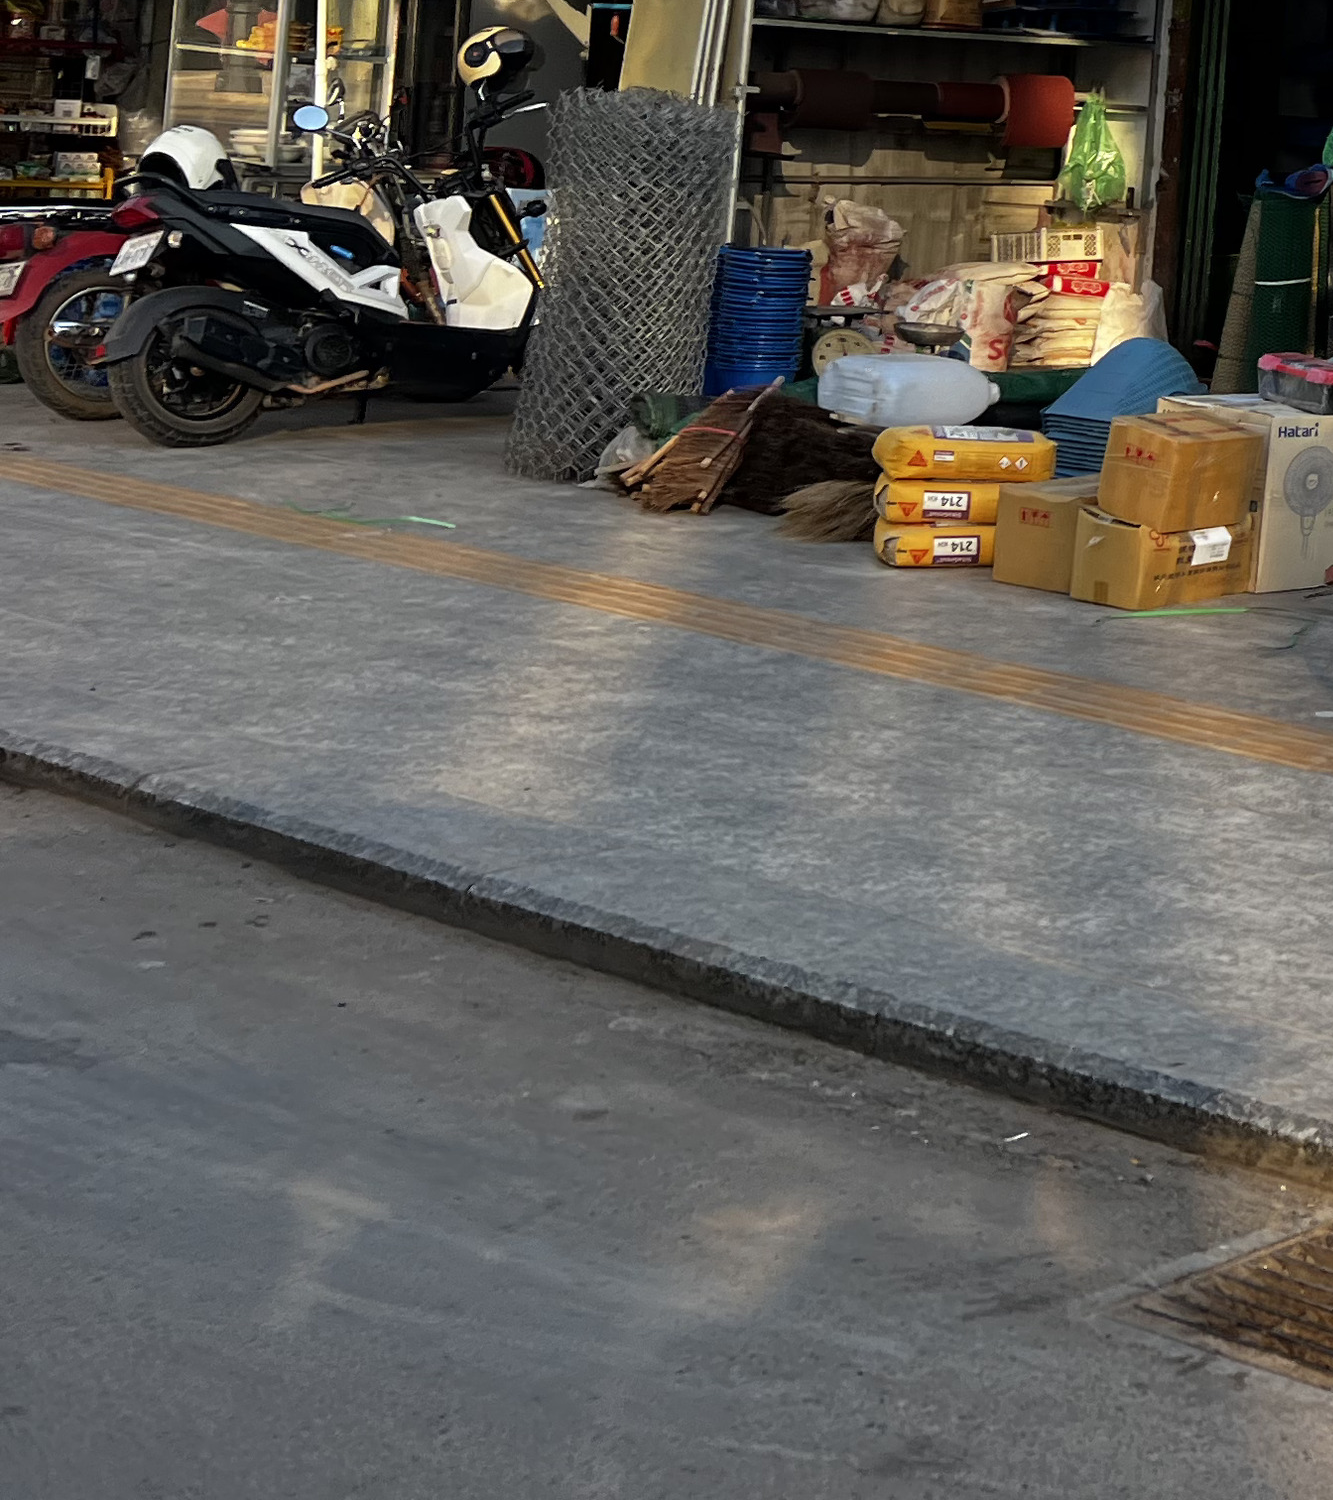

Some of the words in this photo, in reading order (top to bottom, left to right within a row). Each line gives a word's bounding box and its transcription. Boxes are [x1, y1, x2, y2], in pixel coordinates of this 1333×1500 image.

[1278, 422, 1320, 438] Hatari
[940, 496, 963, 507] 214
[950, 540, 973, 552] 214
